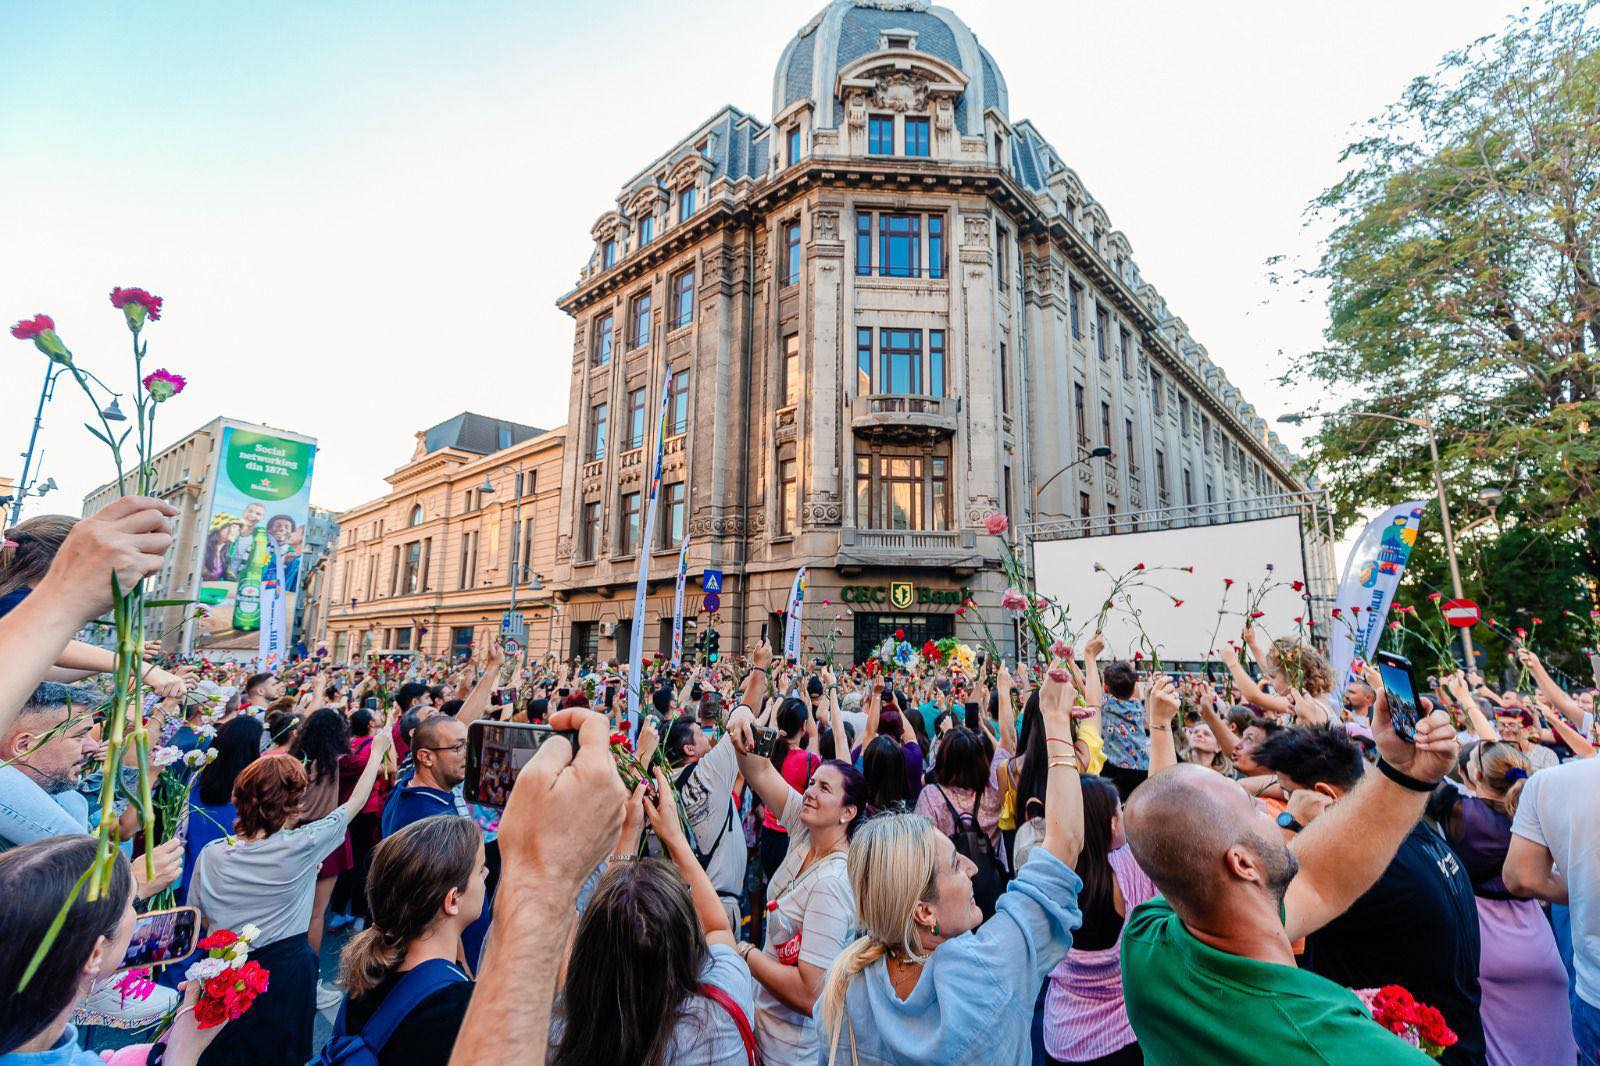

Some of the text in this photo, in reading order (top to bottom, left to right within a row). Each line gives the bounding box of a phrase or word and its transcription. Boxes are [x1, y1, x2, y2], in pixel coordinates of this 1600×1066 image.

[255, 443, 286, 457] Social
[239, 451, 298, 470] networking
[245, 461, 263, 472] din
[840, 585, 974, 604] CEC Bank
[506, 643, 516, 652] 30
